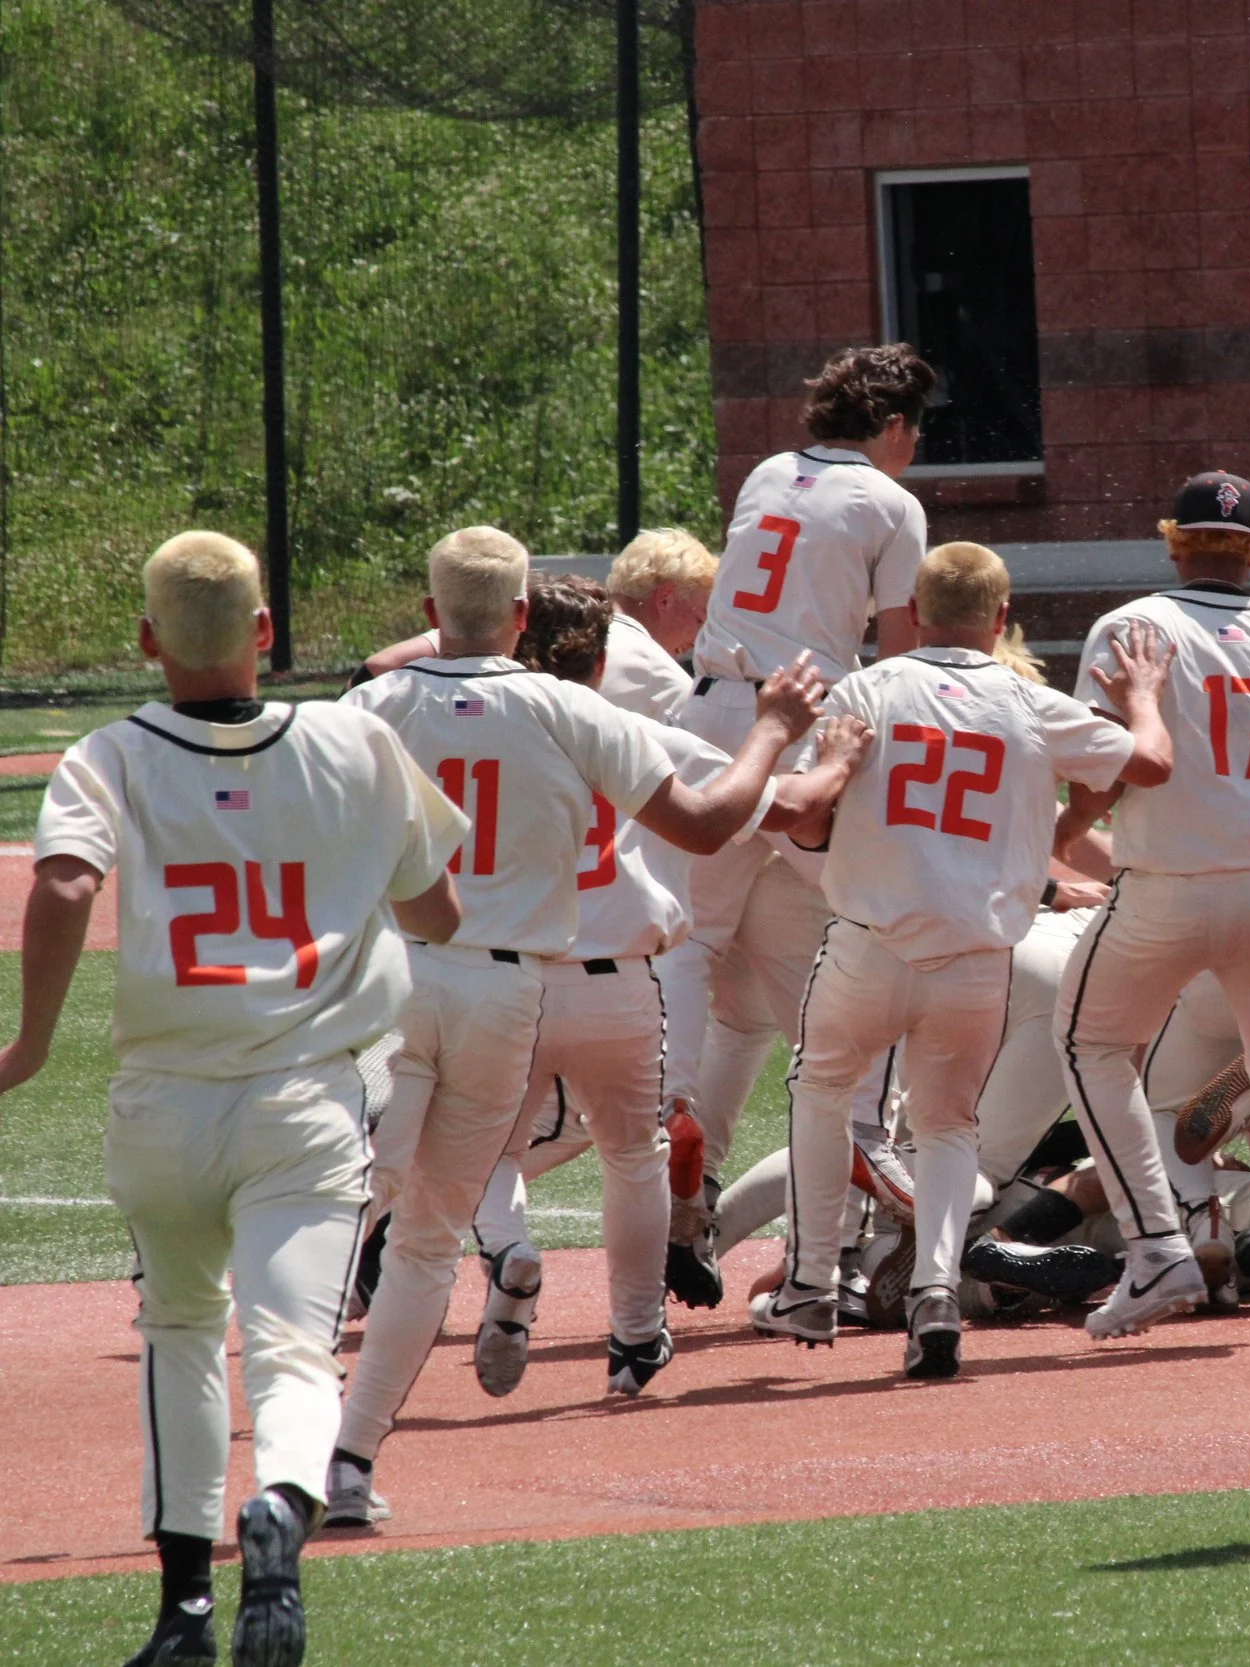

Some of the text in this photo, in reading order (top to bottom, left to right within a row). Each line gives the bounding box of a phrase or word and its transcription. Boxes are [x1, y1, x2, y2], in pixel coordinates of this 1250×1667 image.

[734, 515, 800, 613] 3
[436, 758, 500, 876] 11
[886, 724, 1005, 842] 22
[164, 861, 318, 988] 24
